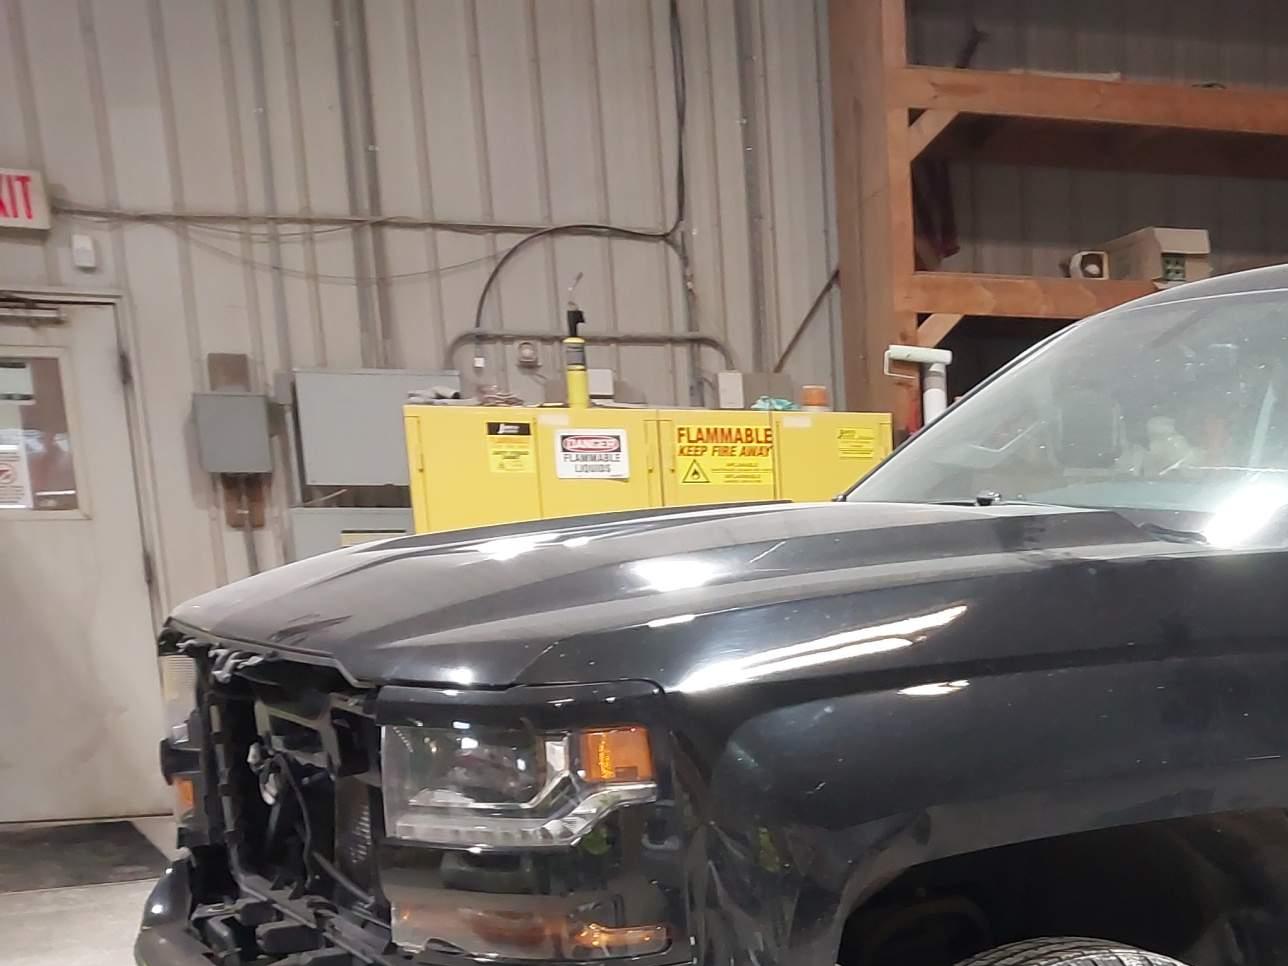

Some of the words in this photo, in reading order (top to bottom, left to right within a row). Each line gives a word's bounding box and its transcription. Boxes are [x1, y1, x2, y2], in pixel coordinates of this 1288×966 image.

[677, 426, 774, 444] FLAMMABLE
[677, 445, 708, 457] KEEP
[711, 445, 737, 457] FIRE
[739, 444, 773, 457] AWAY
[563, 453, 621, 463] FLAMMABLE
[574, 463, 612, 474] LIQUIDS
